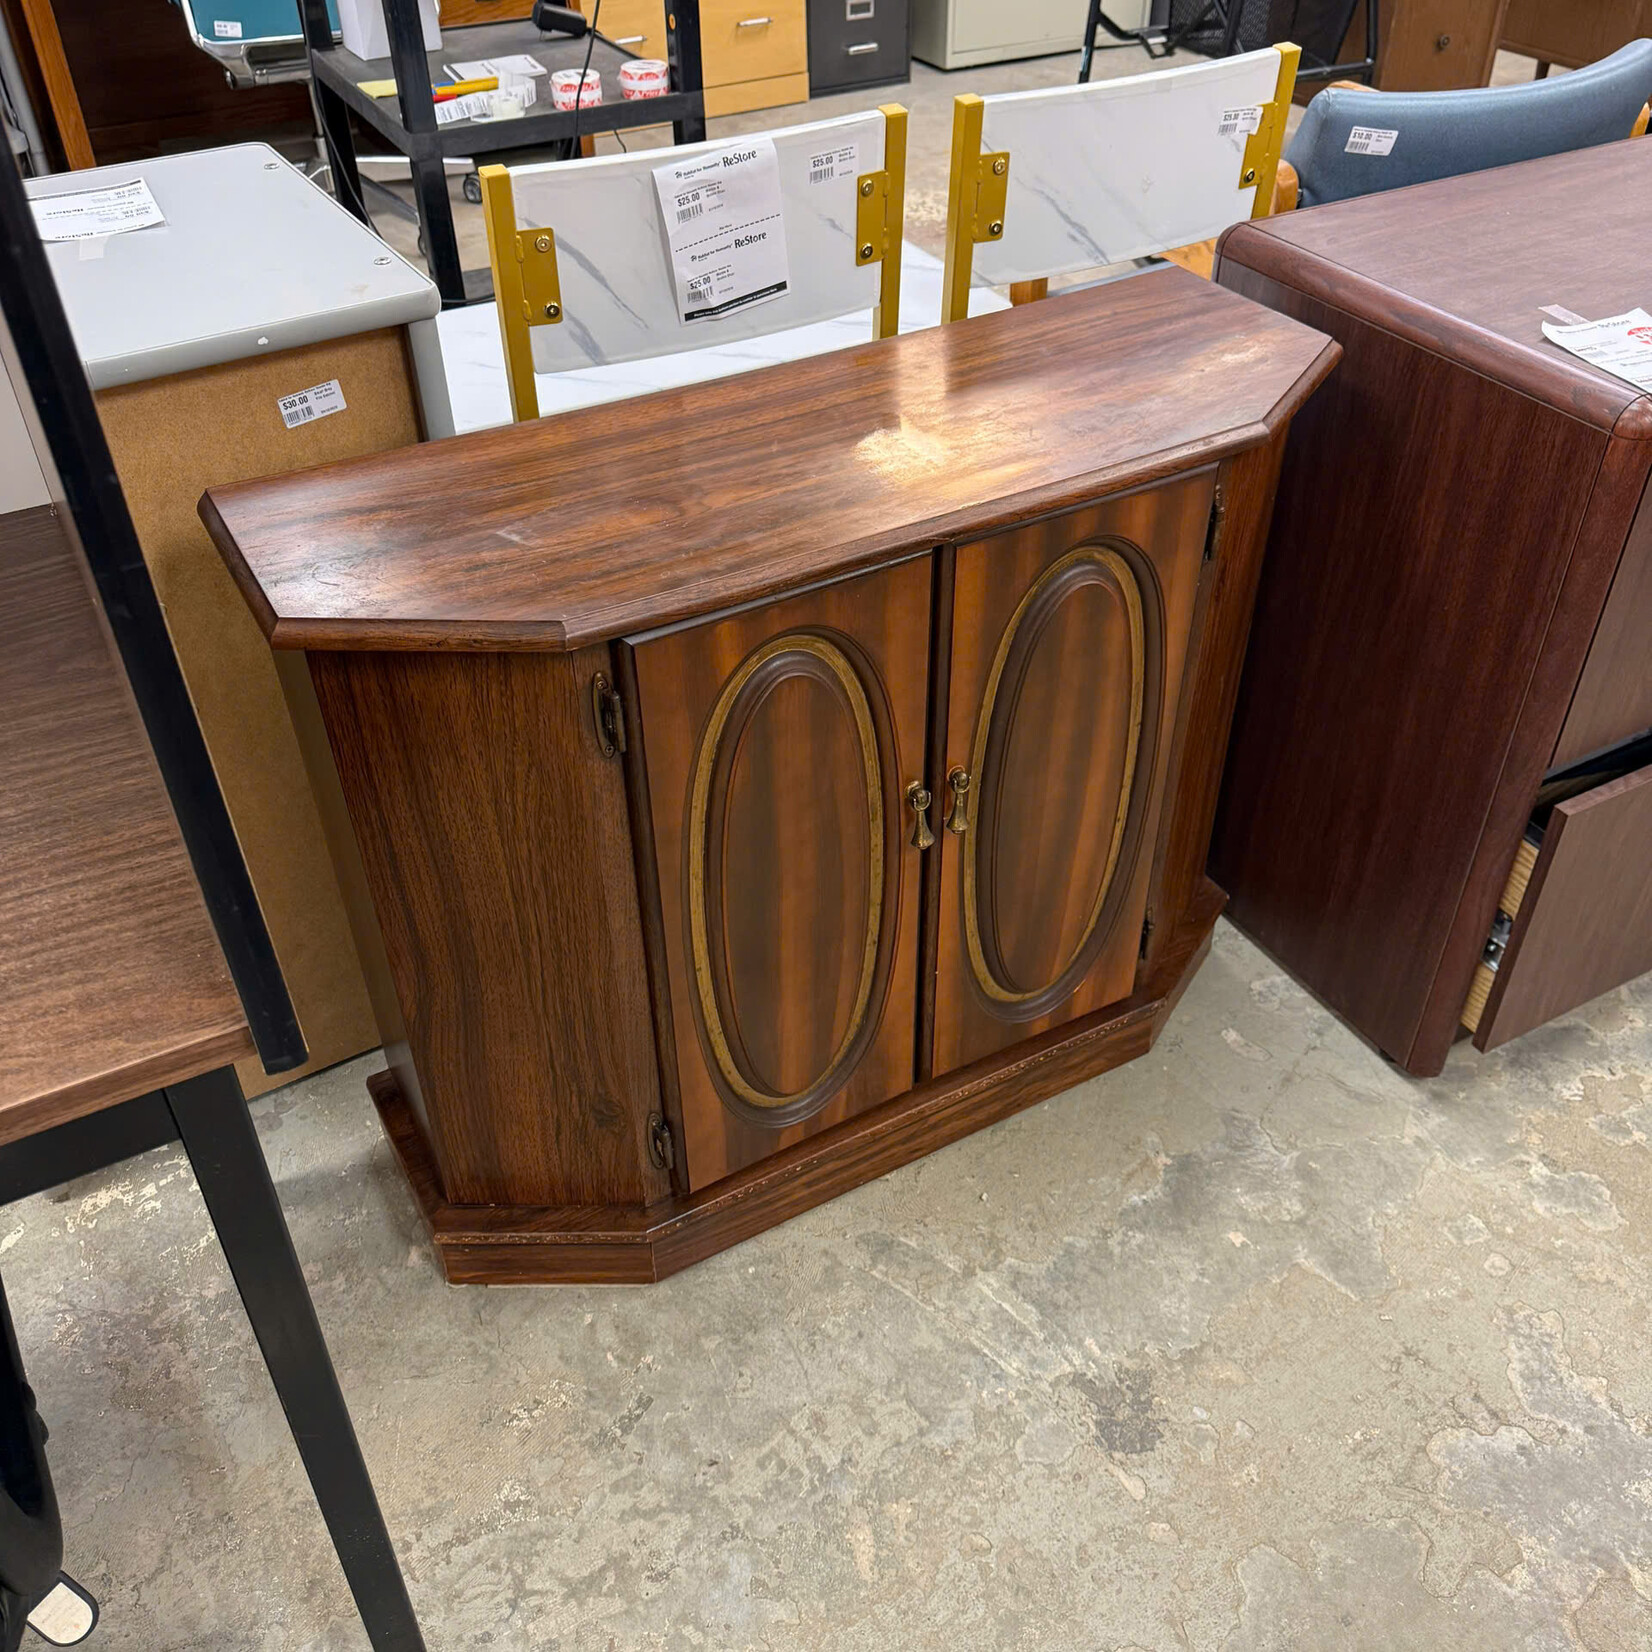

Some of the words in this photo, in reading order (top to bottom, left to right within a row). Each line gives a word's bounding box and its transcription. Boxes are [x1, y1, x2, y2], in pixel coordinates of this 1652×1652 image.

[722, 150, 757, 168] ReStore
[812, 155, 834, 169] $25.00
[677, 191, 701, 207] $25.00
[734, 232, 767, 249] ReStore
[689, 275, 712, 290] $25.00
[283, 395, 308, 410] $30.00
